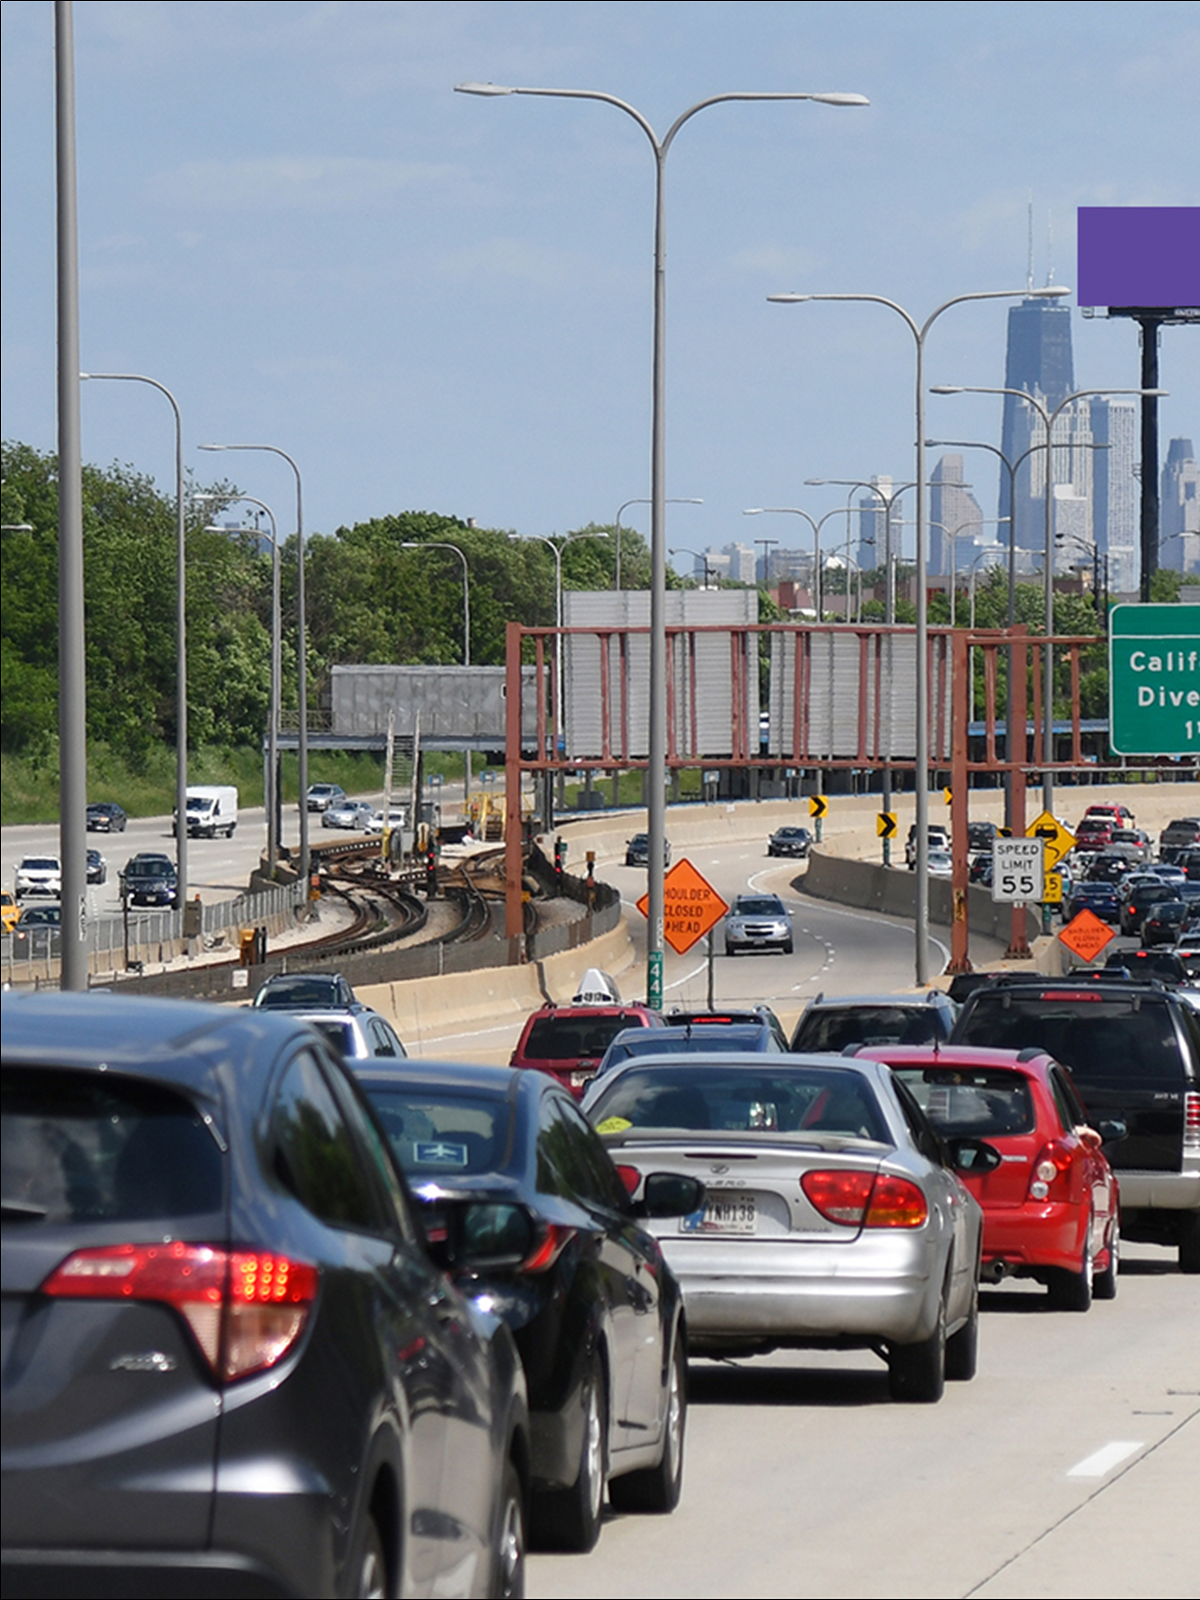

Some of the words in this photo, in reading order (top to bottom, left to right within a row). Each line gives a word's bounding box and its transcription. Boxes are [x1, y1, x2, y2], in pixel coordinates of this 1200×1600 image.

[997, 845, 1039, 855] SPEED
[1001, 859, 1034, 870] LIMIT
[1001, 875, 1034, 894] 55
[664, 887, 711, 900] HOULDER
[664, 904, 704, 918] CLOSED
[664, 920, 701, 934] AHEAD
